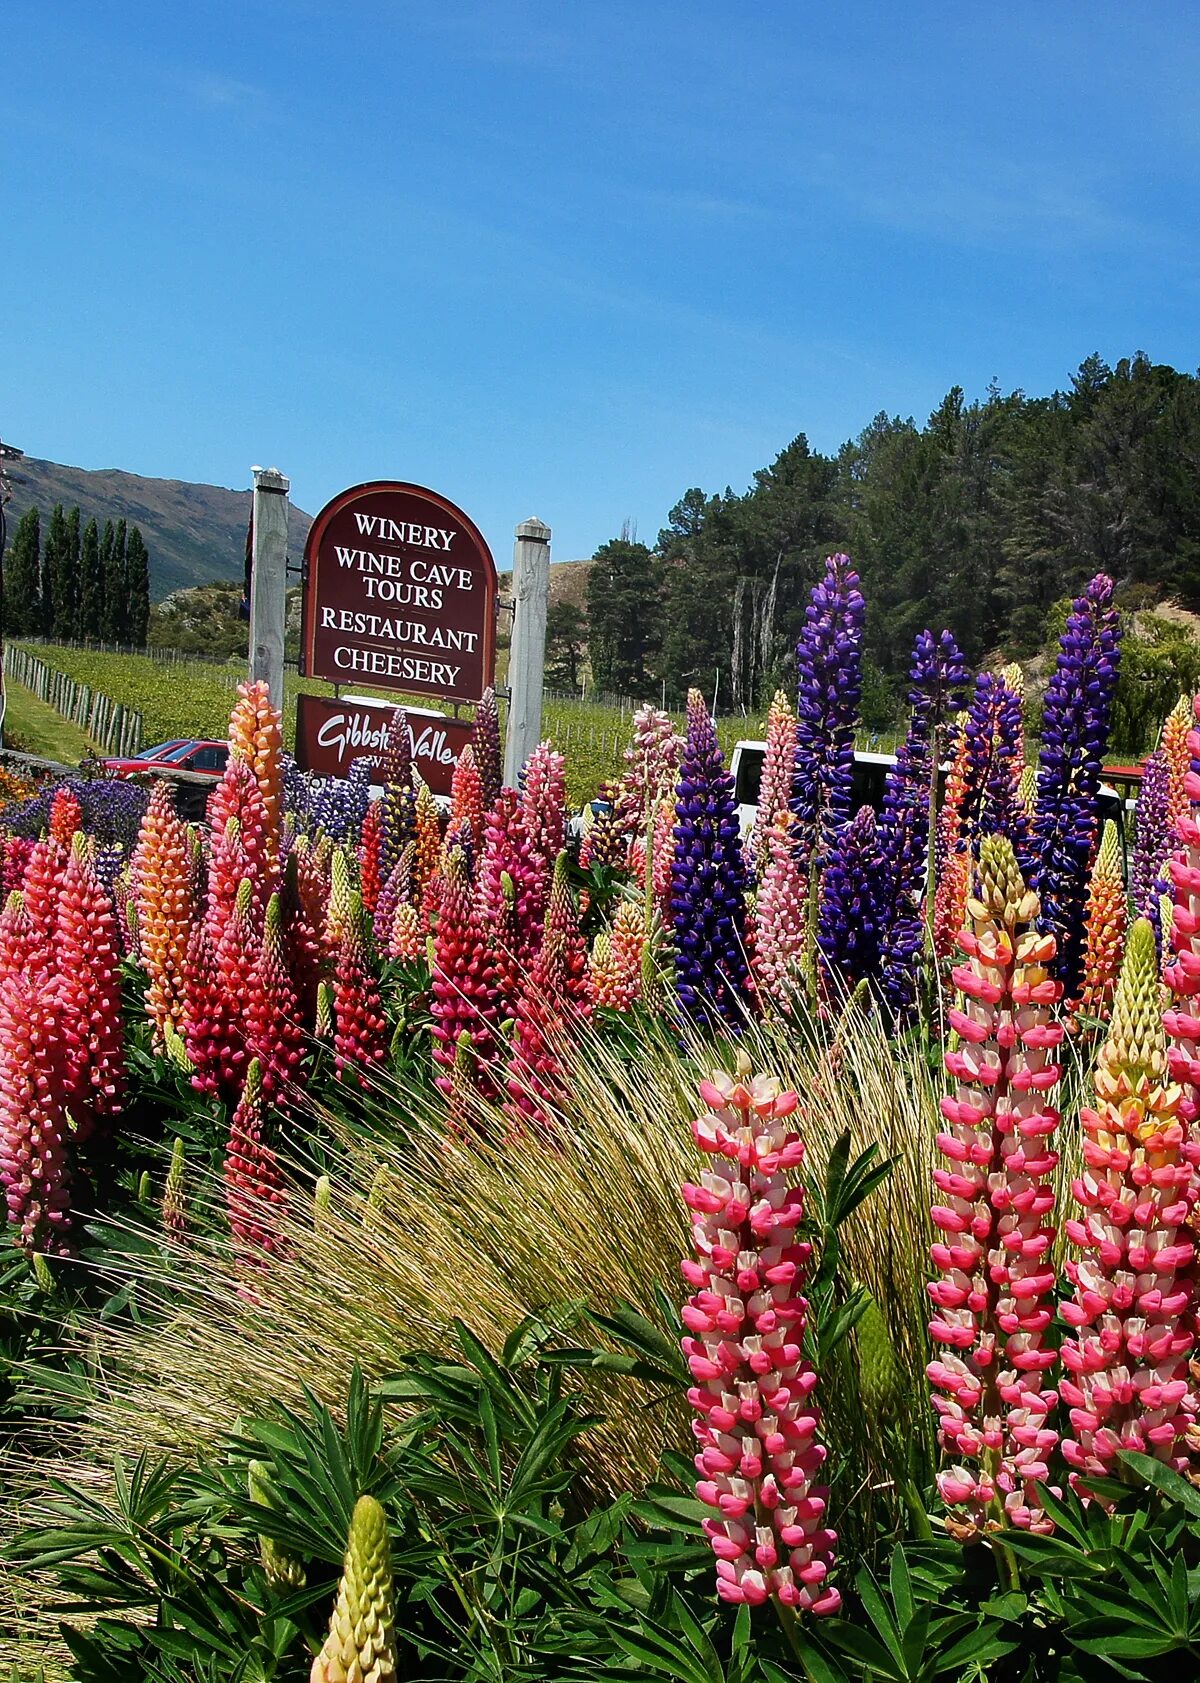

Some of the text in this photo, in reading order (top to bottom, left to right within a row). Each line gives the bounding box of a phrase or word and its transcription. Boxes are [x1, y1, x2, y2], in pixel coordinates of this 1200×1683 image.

[353, 512, 456, 551] WINERY
[334, 546, 473, 590] WINE CAVE
[362, 576, 443, 609] TOURS
[320, 606, 478, 652] RESTAURANT
[333, 646, 461, 686] CHEESERY
